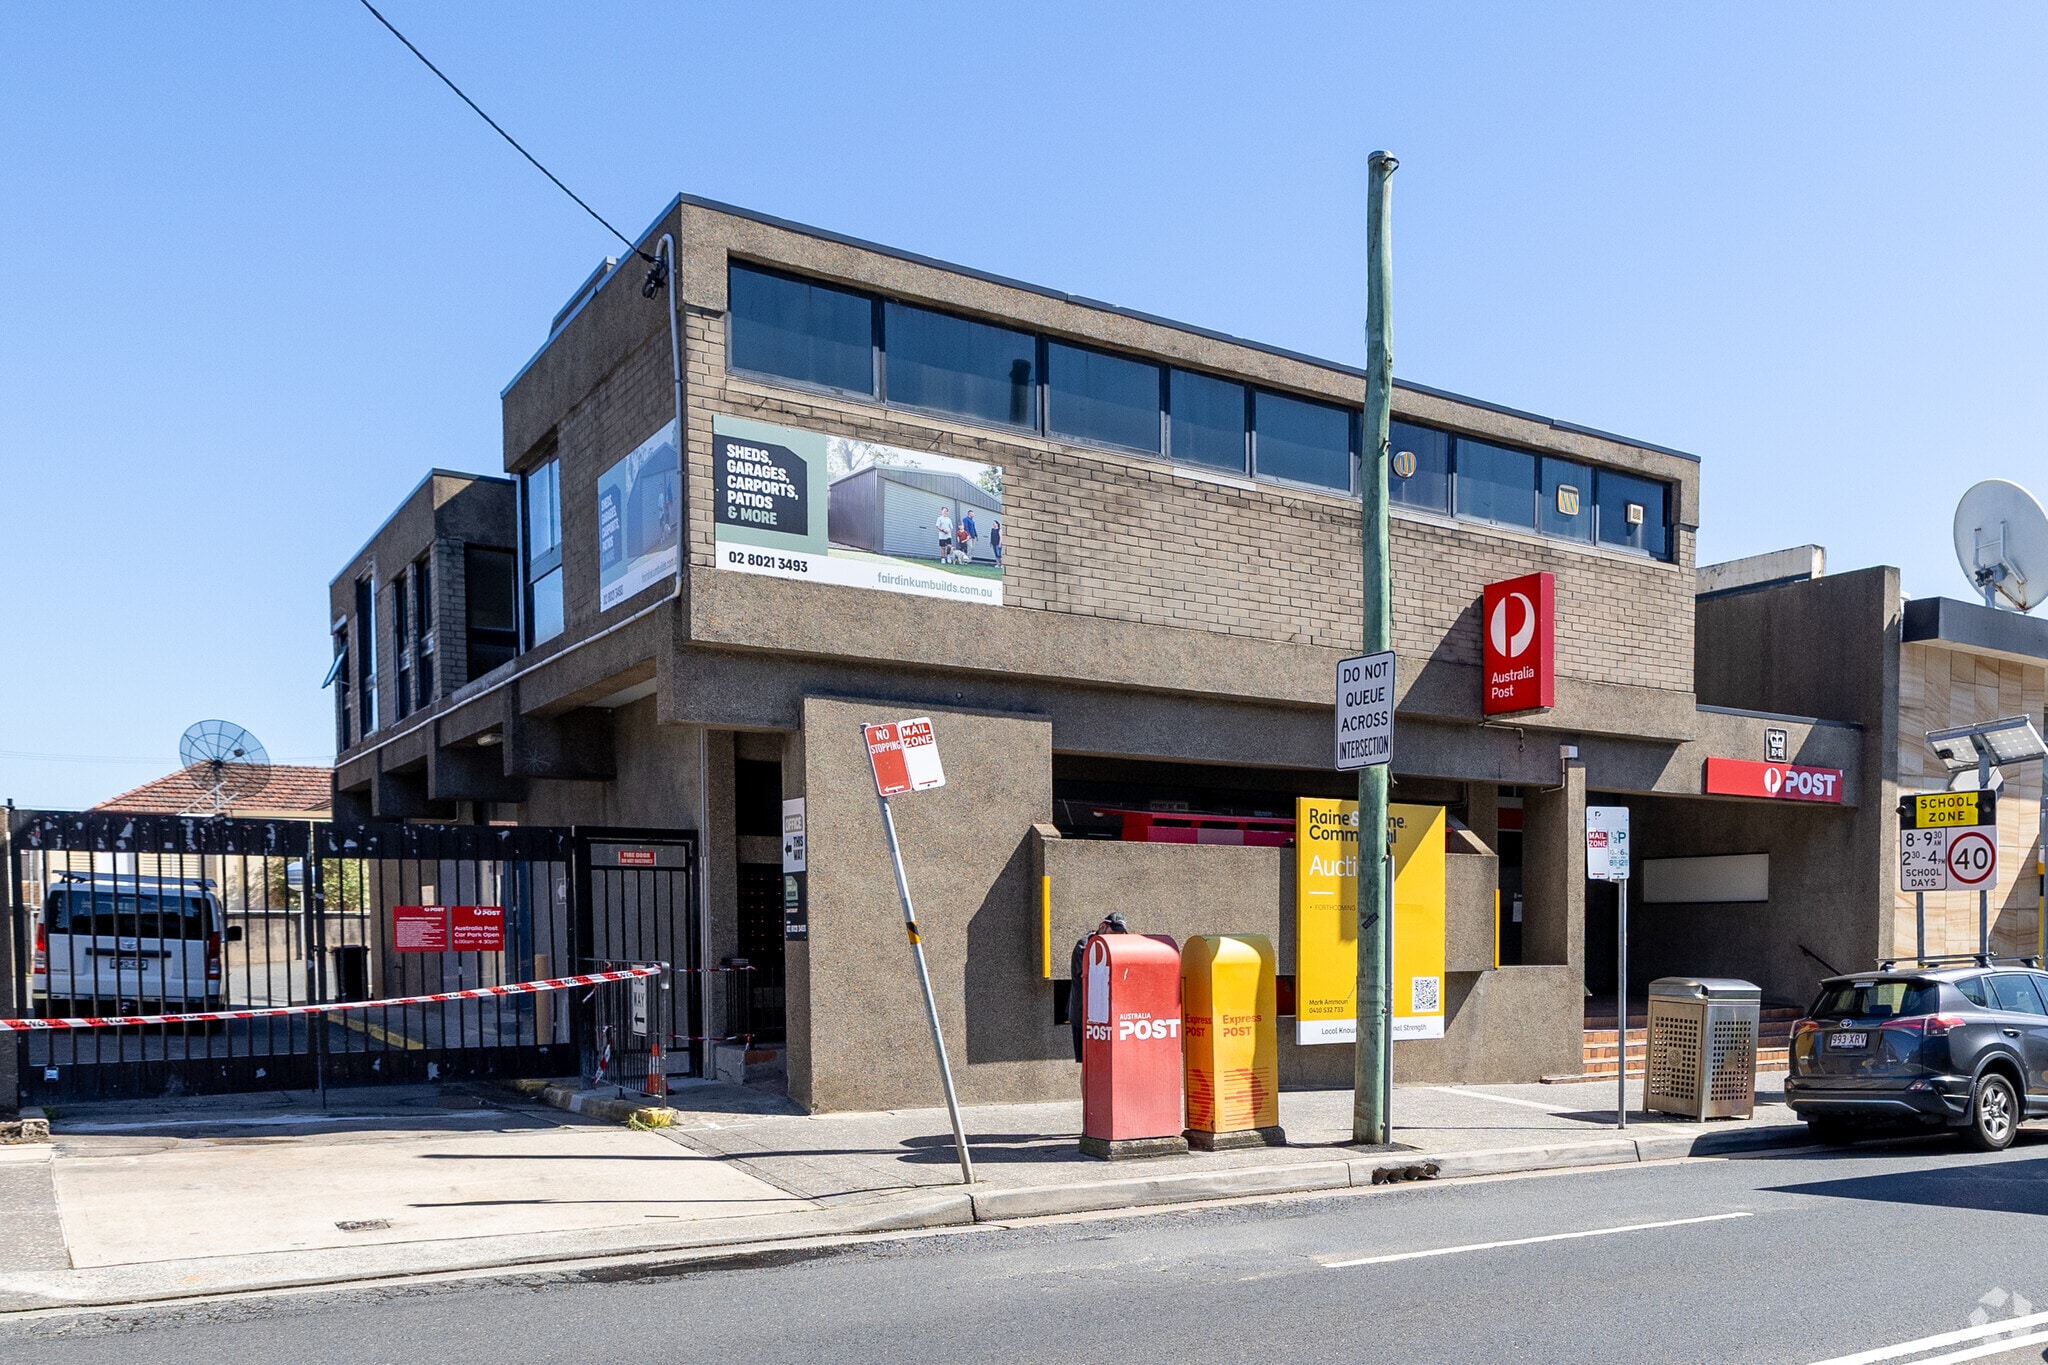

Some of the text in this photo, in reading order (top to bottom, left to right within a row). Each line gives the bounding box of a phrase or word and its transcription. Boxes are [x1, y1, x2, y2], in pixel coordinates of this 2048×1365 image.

[727, 443, 772, 465] SHEDS,
[727, 459, 790, 483] GARAGES,
[727, 474, 798, 500] CARPORTS,
[727, 490, 773, 509] PATIOS
[727, 506, 777, 525] & MORE
[728, 551, 808, 573] 02 8021 3493
[877, 571, 993, 597] fairdinkumbuilds.com.au
[1343, 662, 1388, 683] DO NOT
[1491, 666, 1534, 684] Australia
[1346, 687, 1385, 707] QUEUE
[1491, 685, 1514, 699] Post
[1341, 711, 1388, 732] ACROSS
[875, 729, 890, 741] NO
[902, 724, 930, 737] MAIL
[870, 740, 900, 755] STOPPING
[904, 734, 933, 747] ZONE
[1339, 735, 1389, 760] INTERSECTION
[1785, 770, 1836, 797] POST
[1920, 796, 1973, 809] SCHOOL
[1928, 810, 1965, 823] ZONE
[793, 835, 803, 848] THIS
[1588, 832, 1606, 840] MAIL
[1588, 840, 1607, 848] ZONE
[1309, 854, 1358, 877] Aucti
[1954, 847, 1988, 870] 40
[1905, 868, 1942, 877] SCHOOL
[1911, 878, 1936, 887] DAYS
[551, 977, 590, 987] DANGER
[1119, 1012, 1151, 1020] AUSTRALIA
[1185, 1014, 1213, 1026] Express
[1222, 1015, 1262, 1026] Express
[10, 1020, 64, 1028] DANGER
[1119, 1018, 1181, 1041] POST
[1086, 1025, 1112, 1041] POST
[1185, 1027, 1206, 1037] POST
[1223, 1026, 1252, 1037] POST
